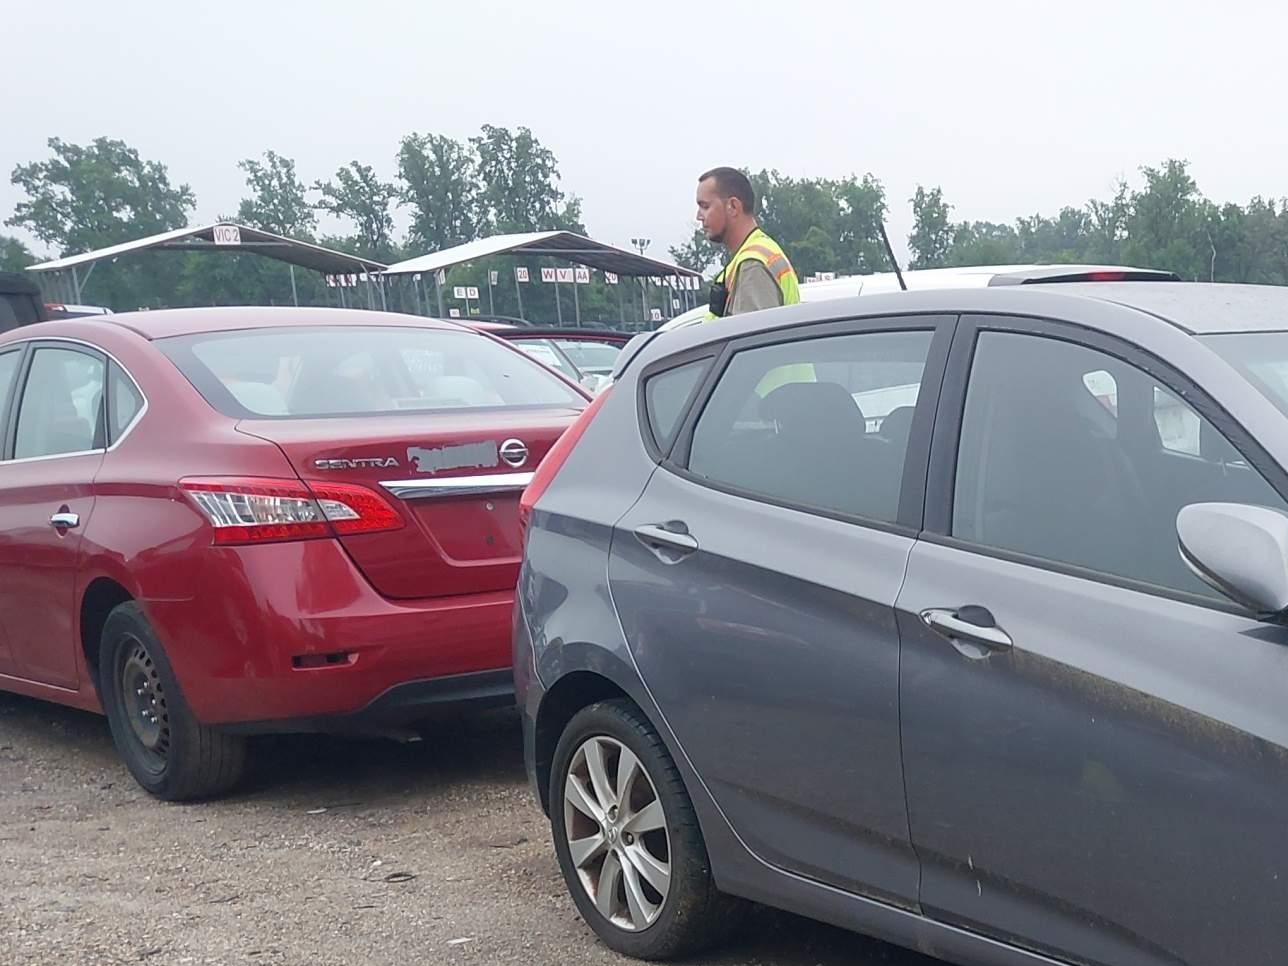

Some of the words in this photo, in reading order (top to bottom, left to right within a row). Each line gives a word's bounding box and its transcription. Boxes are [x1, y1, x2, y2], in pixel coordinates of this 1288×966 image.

[214, 228, 231, 242] VIC
[233, 228, 240, 242] 2
[543, 269, 553, 280] W
[577, 271, 588, 281] AA
[315, 457, 400, 470] SENTRA
